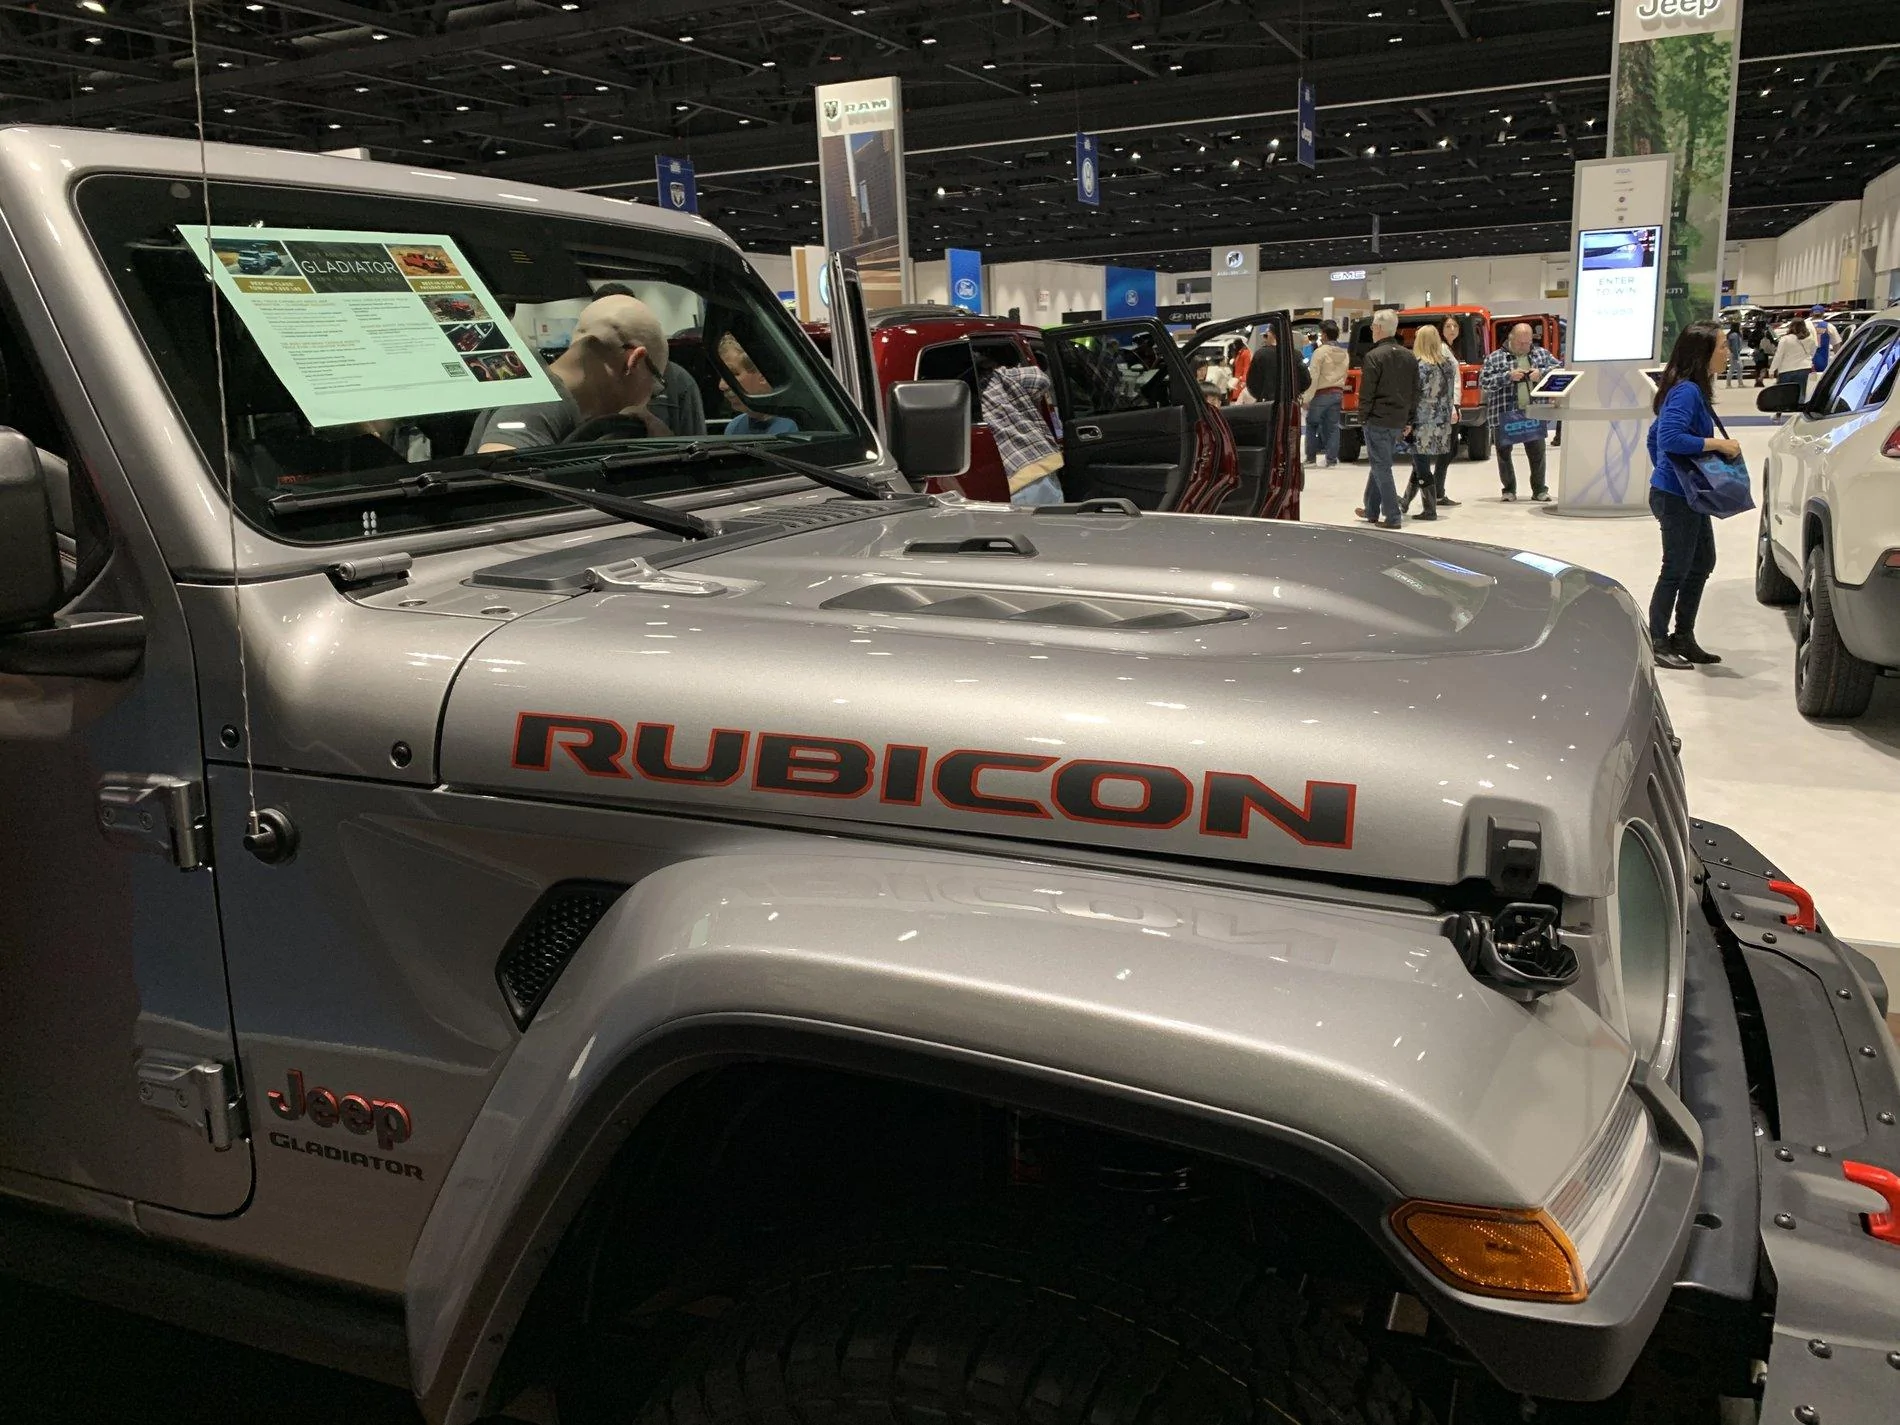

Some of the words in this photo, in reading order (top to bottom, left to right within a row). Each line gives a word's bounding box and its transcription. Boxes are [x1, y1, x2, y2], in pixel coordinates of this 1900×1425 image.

[1638, 0, 1718, 17] Jeep
[844, 99, 887, 113] RAM
[301, 260, 399, 275] GLADIATOR
[1330, 270, 1366, 281] GMC
[1598, 276, 1635, 286] ENTER
[1596, 287, 1610, 296] TO
[1615, 286, 1637, 296] WIN
[511, 711, 1358, 851] RUBICON
[267, 1068, 412, 1150] Jeep
[268, 1131, 425, 1181] GLADIATOR
